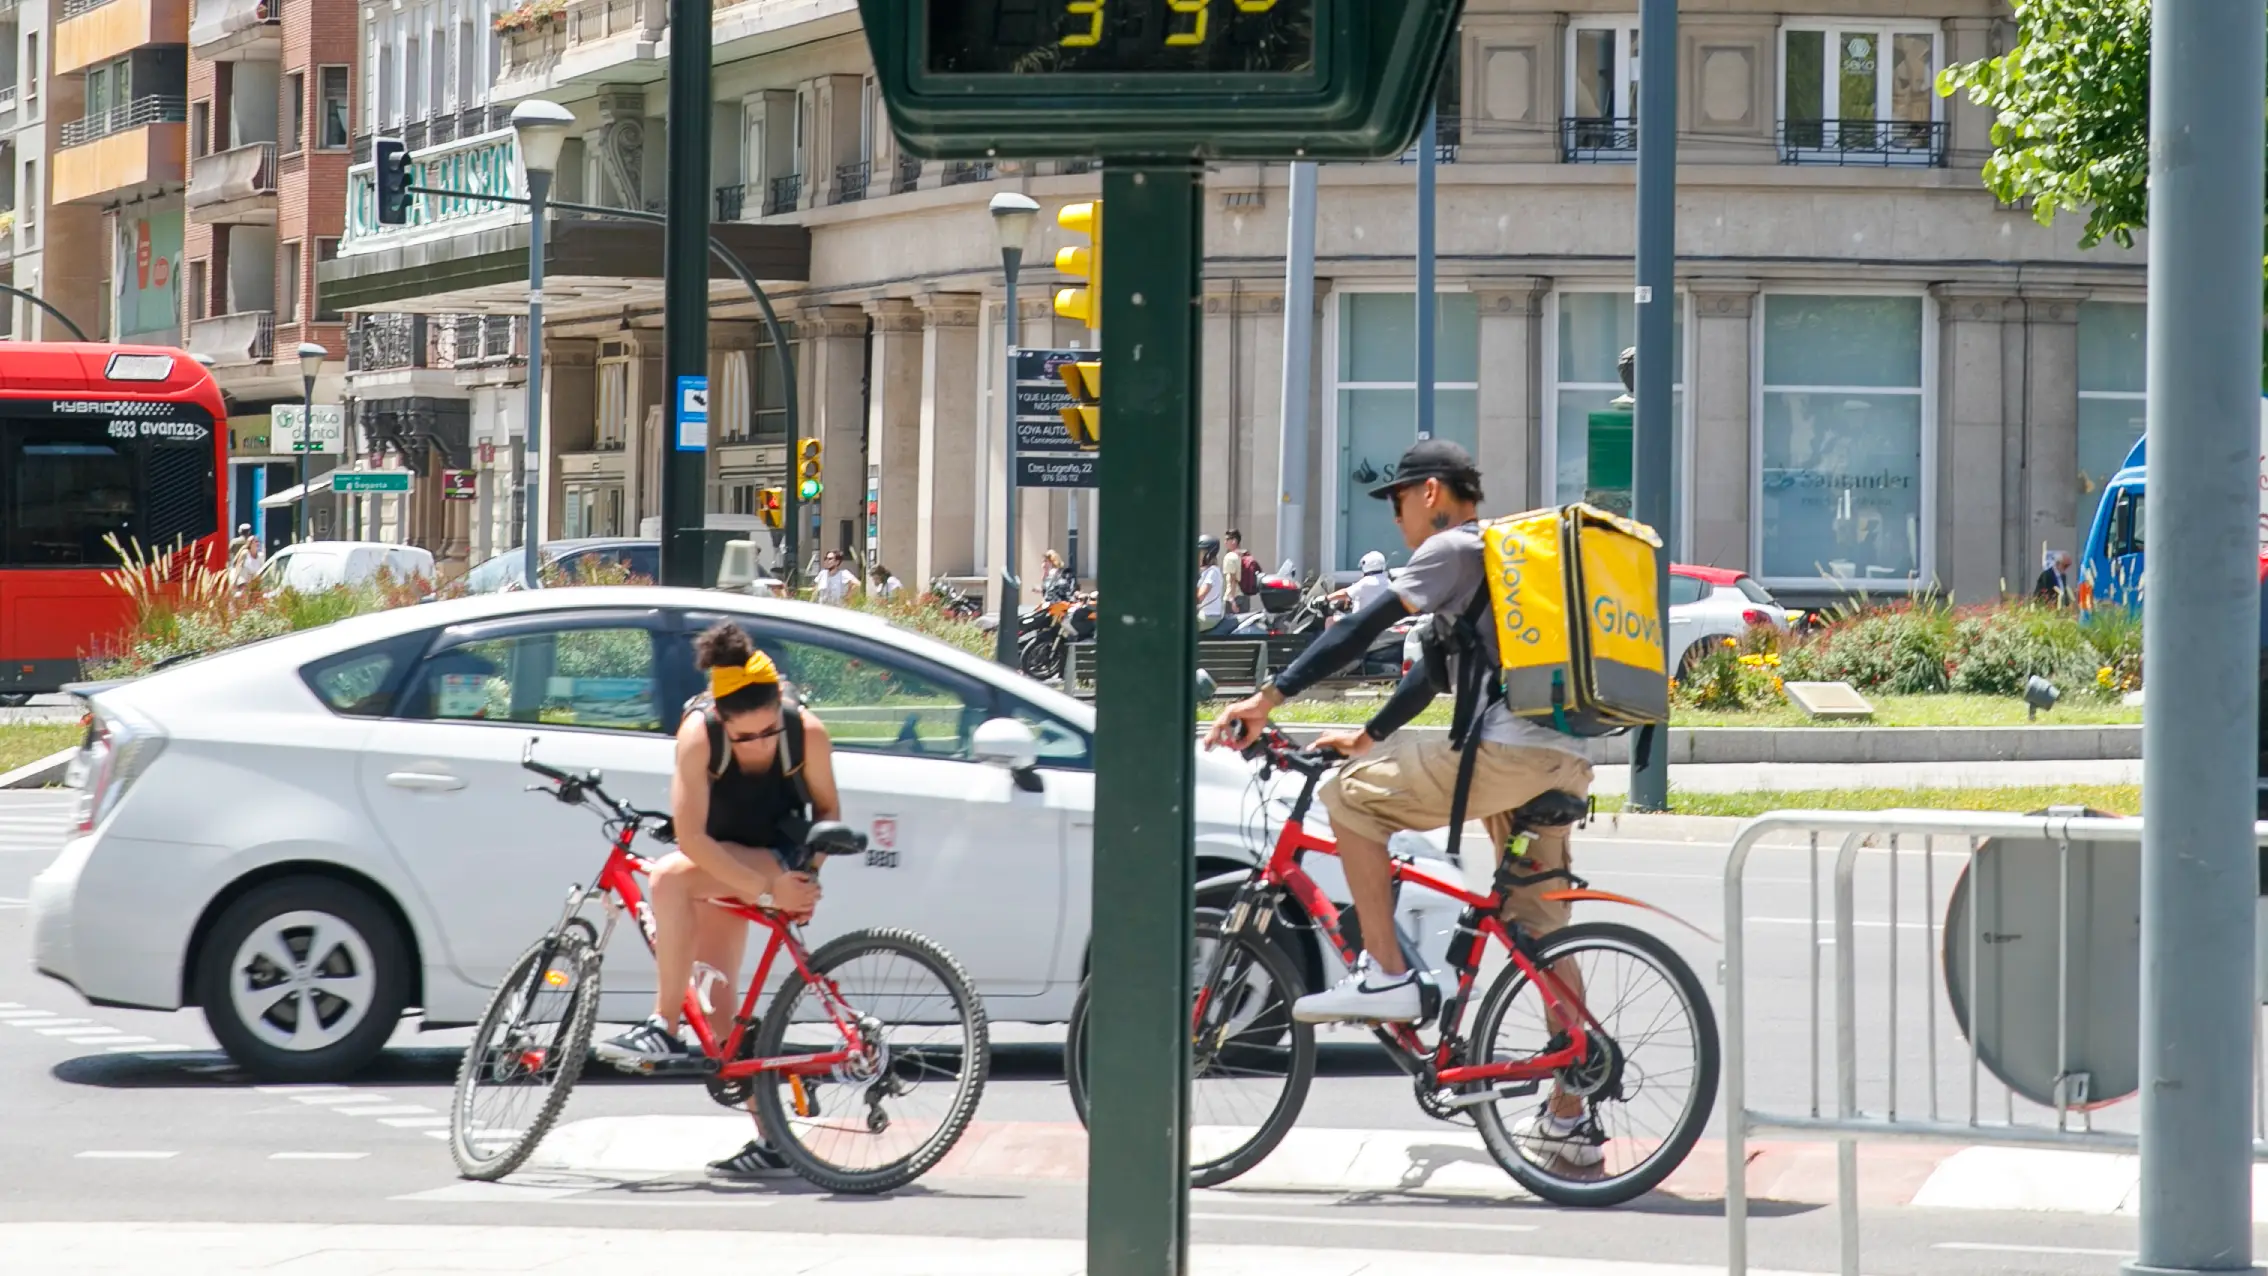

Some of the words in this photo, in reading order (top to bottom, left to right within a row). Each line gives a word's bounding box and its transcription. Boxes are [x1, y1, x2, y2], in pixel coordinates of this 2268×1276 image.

[52, 401, 114, 413] HYBRID
[107, 420, 136, 438] 4933
[140, 421, 195, 436] avanza
[292, 426, 339, 439] dntal
[1042, 426, 1070, 435] AUTO
[1081, 463, 1093, 473] 22
[1501, 533, 1528, 631] Glovo
